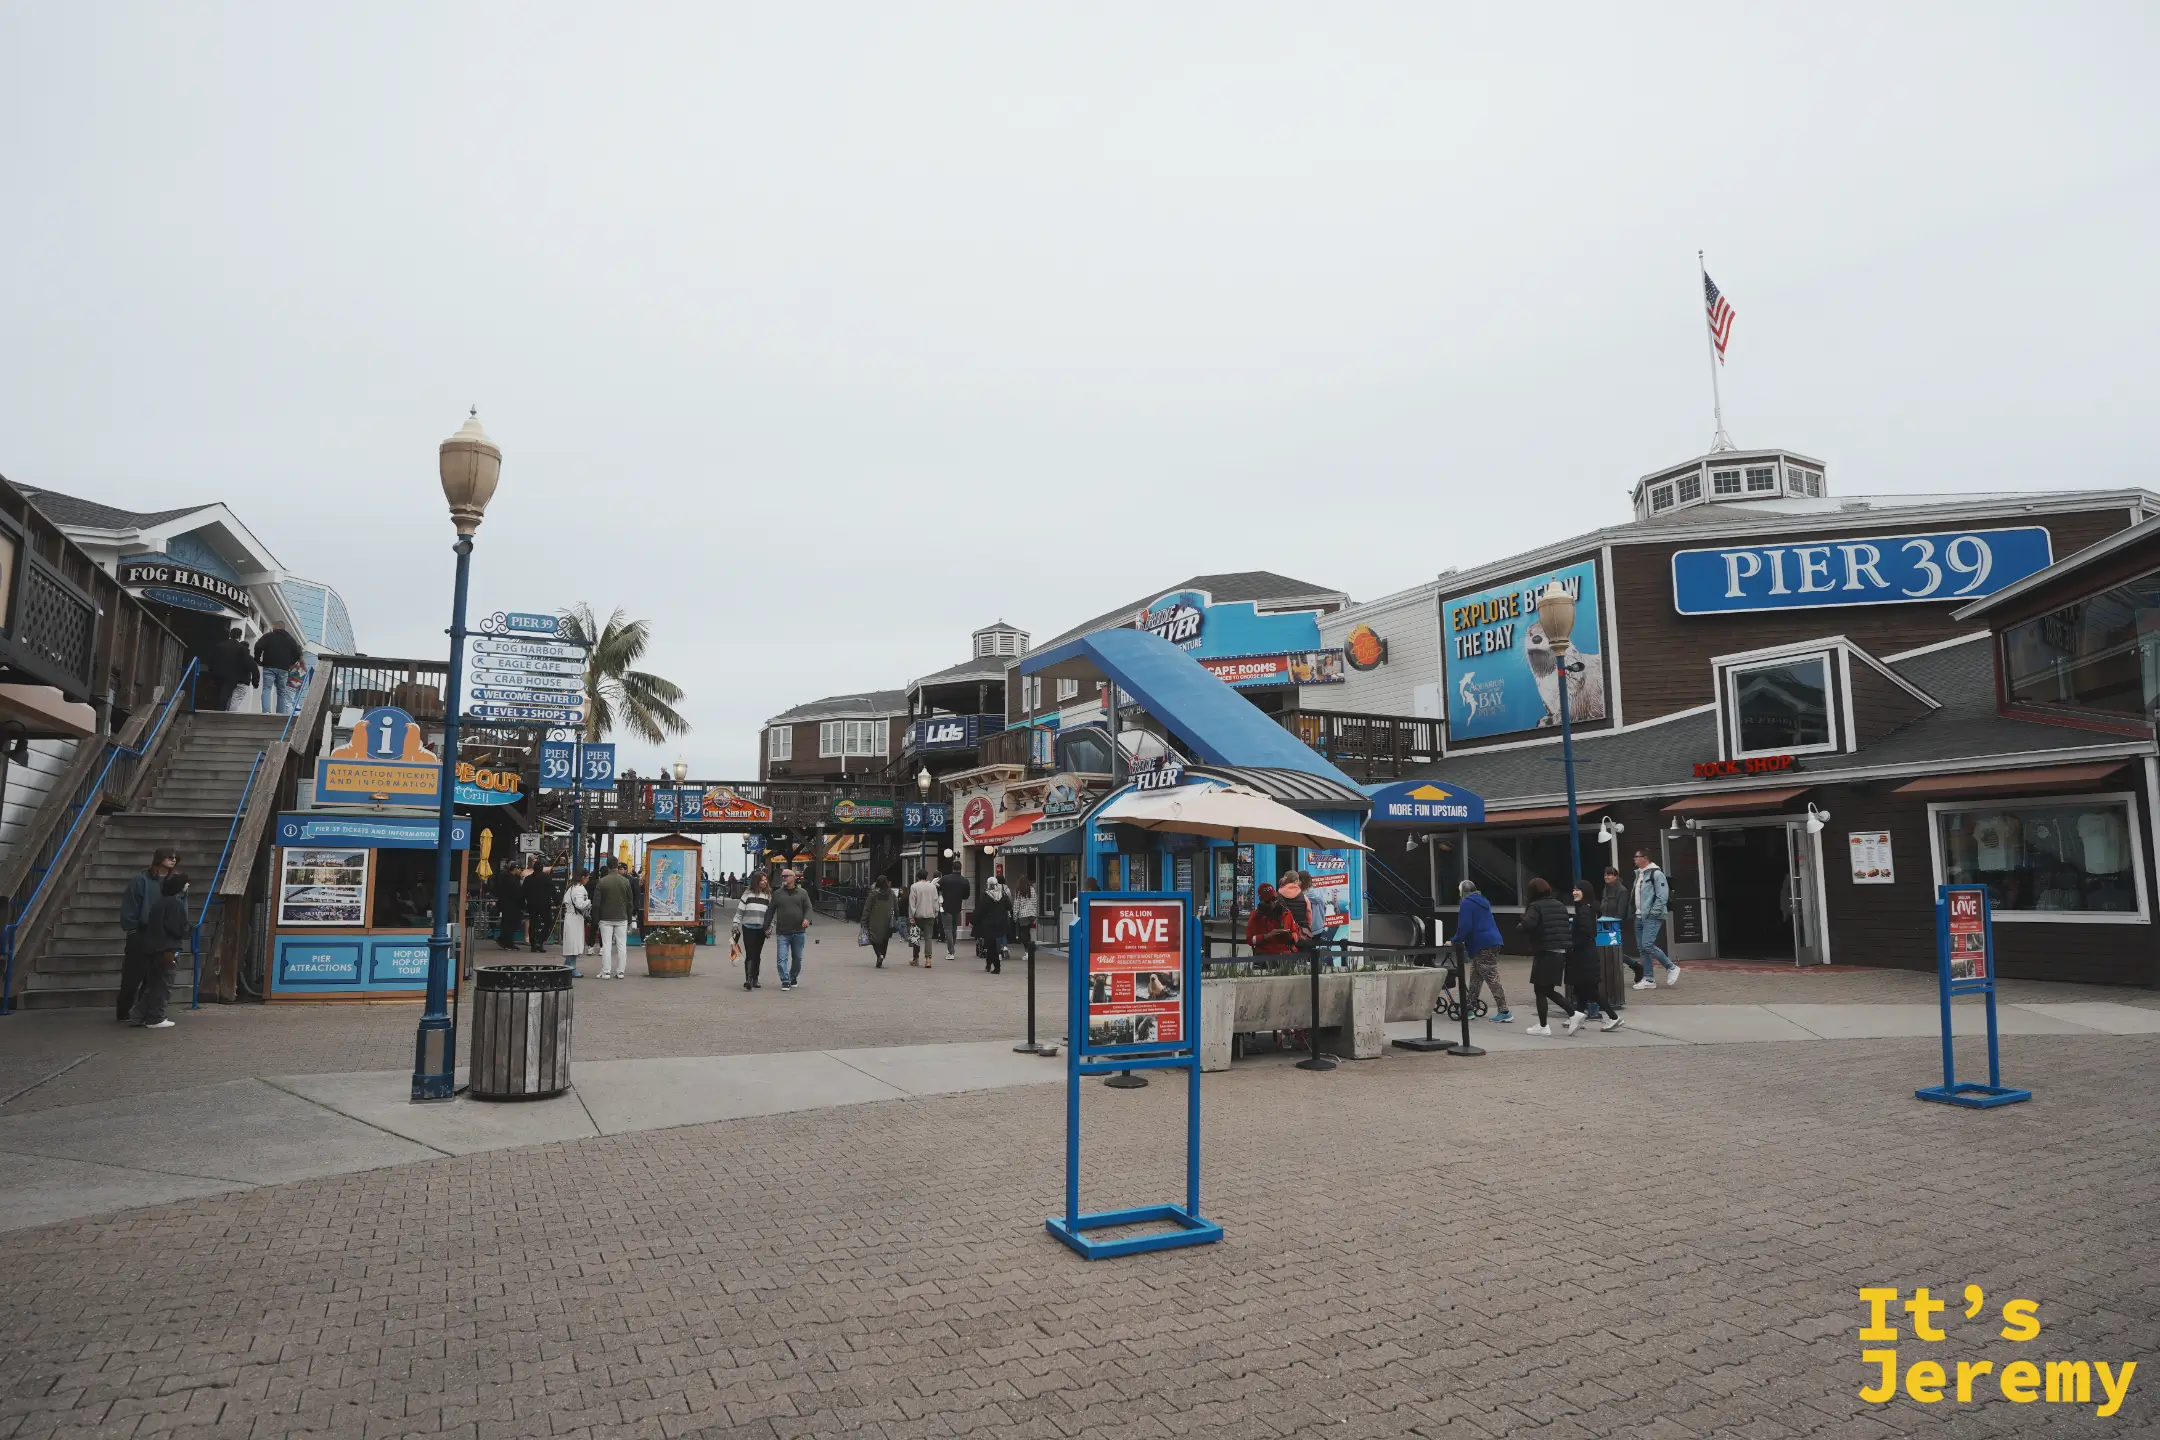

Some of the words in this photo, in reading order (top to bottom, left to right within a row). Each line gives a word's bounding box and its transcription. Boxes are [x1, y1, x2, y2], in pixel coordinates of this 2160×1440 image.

[1720, 543, 1890, 598] PIER
[1901, 535, 1993, 597] 39
[128, 566, 169, 581] FOG
[174, 569, 250, 607] HARBOR
[1452, 592, 1519, 631] EXPLORE
[1523, 576, 1581, 613] BEW
[511, 616, 539, 629] PIER
[539, 618, 554, 629] 39
[1454, 632, 1482, 659] THE
[1485, 624, 1514, 653] BAY
[496, 643, 517, 653] FOG
[520, 645, 564, 656] HARBOR
[498, 659, 532, 669] EAGLE
[535, 661, 561, 672] CAFE
[1239, 663, 1277, 674] ROOMS
[495, 675, 523, 685] CRAB
[526, 677, 562, 687] HOUSE
[484, 690, 532, 702] WELCOME
[533, 693, 569, 704] CENTER
[1479, 692, 1504, 708] BAY
[487, 706, 519, 717] LEVEL
[522, 709, 529, 718] 2
[531, 709, 566, 720] SHOPS
[927, 724, 964, 743] Lids
[544, 749, 569, 759] PIER
[586, 751, 610, 760] PIER
[543, 759, 570, 779] 39
[585, 762, 612, 780] 39
[1693, 760, 1737, 777] ROCK
[1745, 755, 1792, 773] SHOP
[330, 768, 393, 778] ATTRACTION
[397, 771, 436, 780] TICKETS
[1137, 769, 1178, 790] FLYER
[329, 777, 352, 785] AND
[358, 779, 434, 788] INFORMATION
[462, 786, 489, 803] Grill
[656, 801, 674, 814] 39
[683, 801, 701, 815] 39
[1389, 803, 1413, 816] MORE
[1414, 804, 1430, 817] FUN
[1432, 804, 1468, 818] UPSTAIRS
[904, 814, 920, 827] 39
[929, 814, 944, 827] 39
[1316, 861, 1345, 869] FLYER
[1951, 900, 1977, 916] LOVE
[1102, 918, 1169, 943] LOVE
[312, 955, 331, 963] PIER
[393, 950, 412, 958] HOP
[413, 950, 428, 958] ON
[1097, 955, 1115, 964] Visit
[289, 964, 352, 972] ATTRACTIONS
[392, 958, 412, 966] HOP
[413, 958, 428, 966] OFF
[398, 966, 421, 974] TOUR
